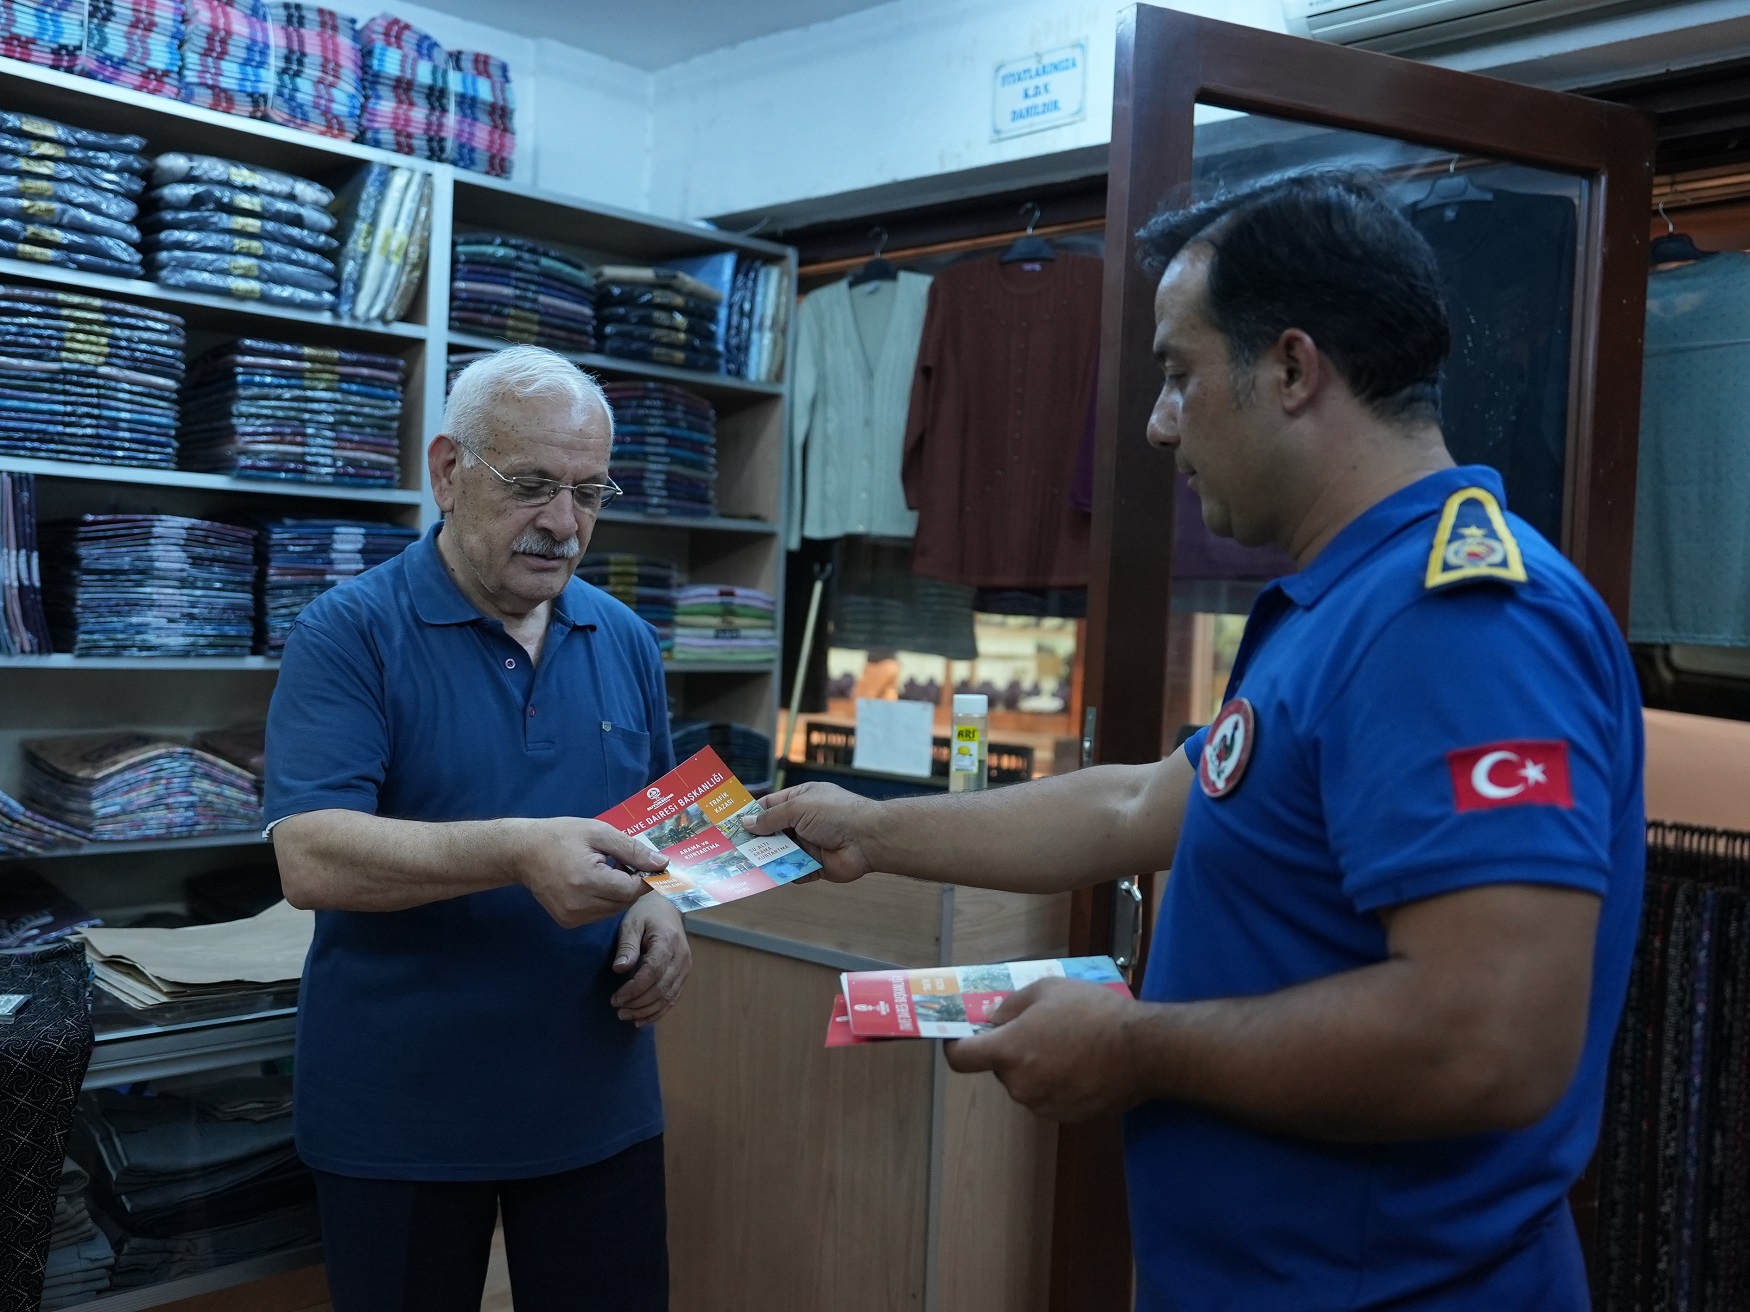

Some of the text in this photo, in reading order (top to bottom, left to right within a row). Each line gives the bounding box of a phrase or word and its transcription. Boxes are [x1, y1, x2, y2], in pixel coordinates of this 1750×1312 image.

[645, 803, 679, 825] DAİRESİ
[677, 772, 724, 807] BAŞKANLIĞI
[709, 792, 730, 807] TRAFİK
[714, 799, 734, 814] KAZASI
[679, 843, 701, 855] ARAMA
